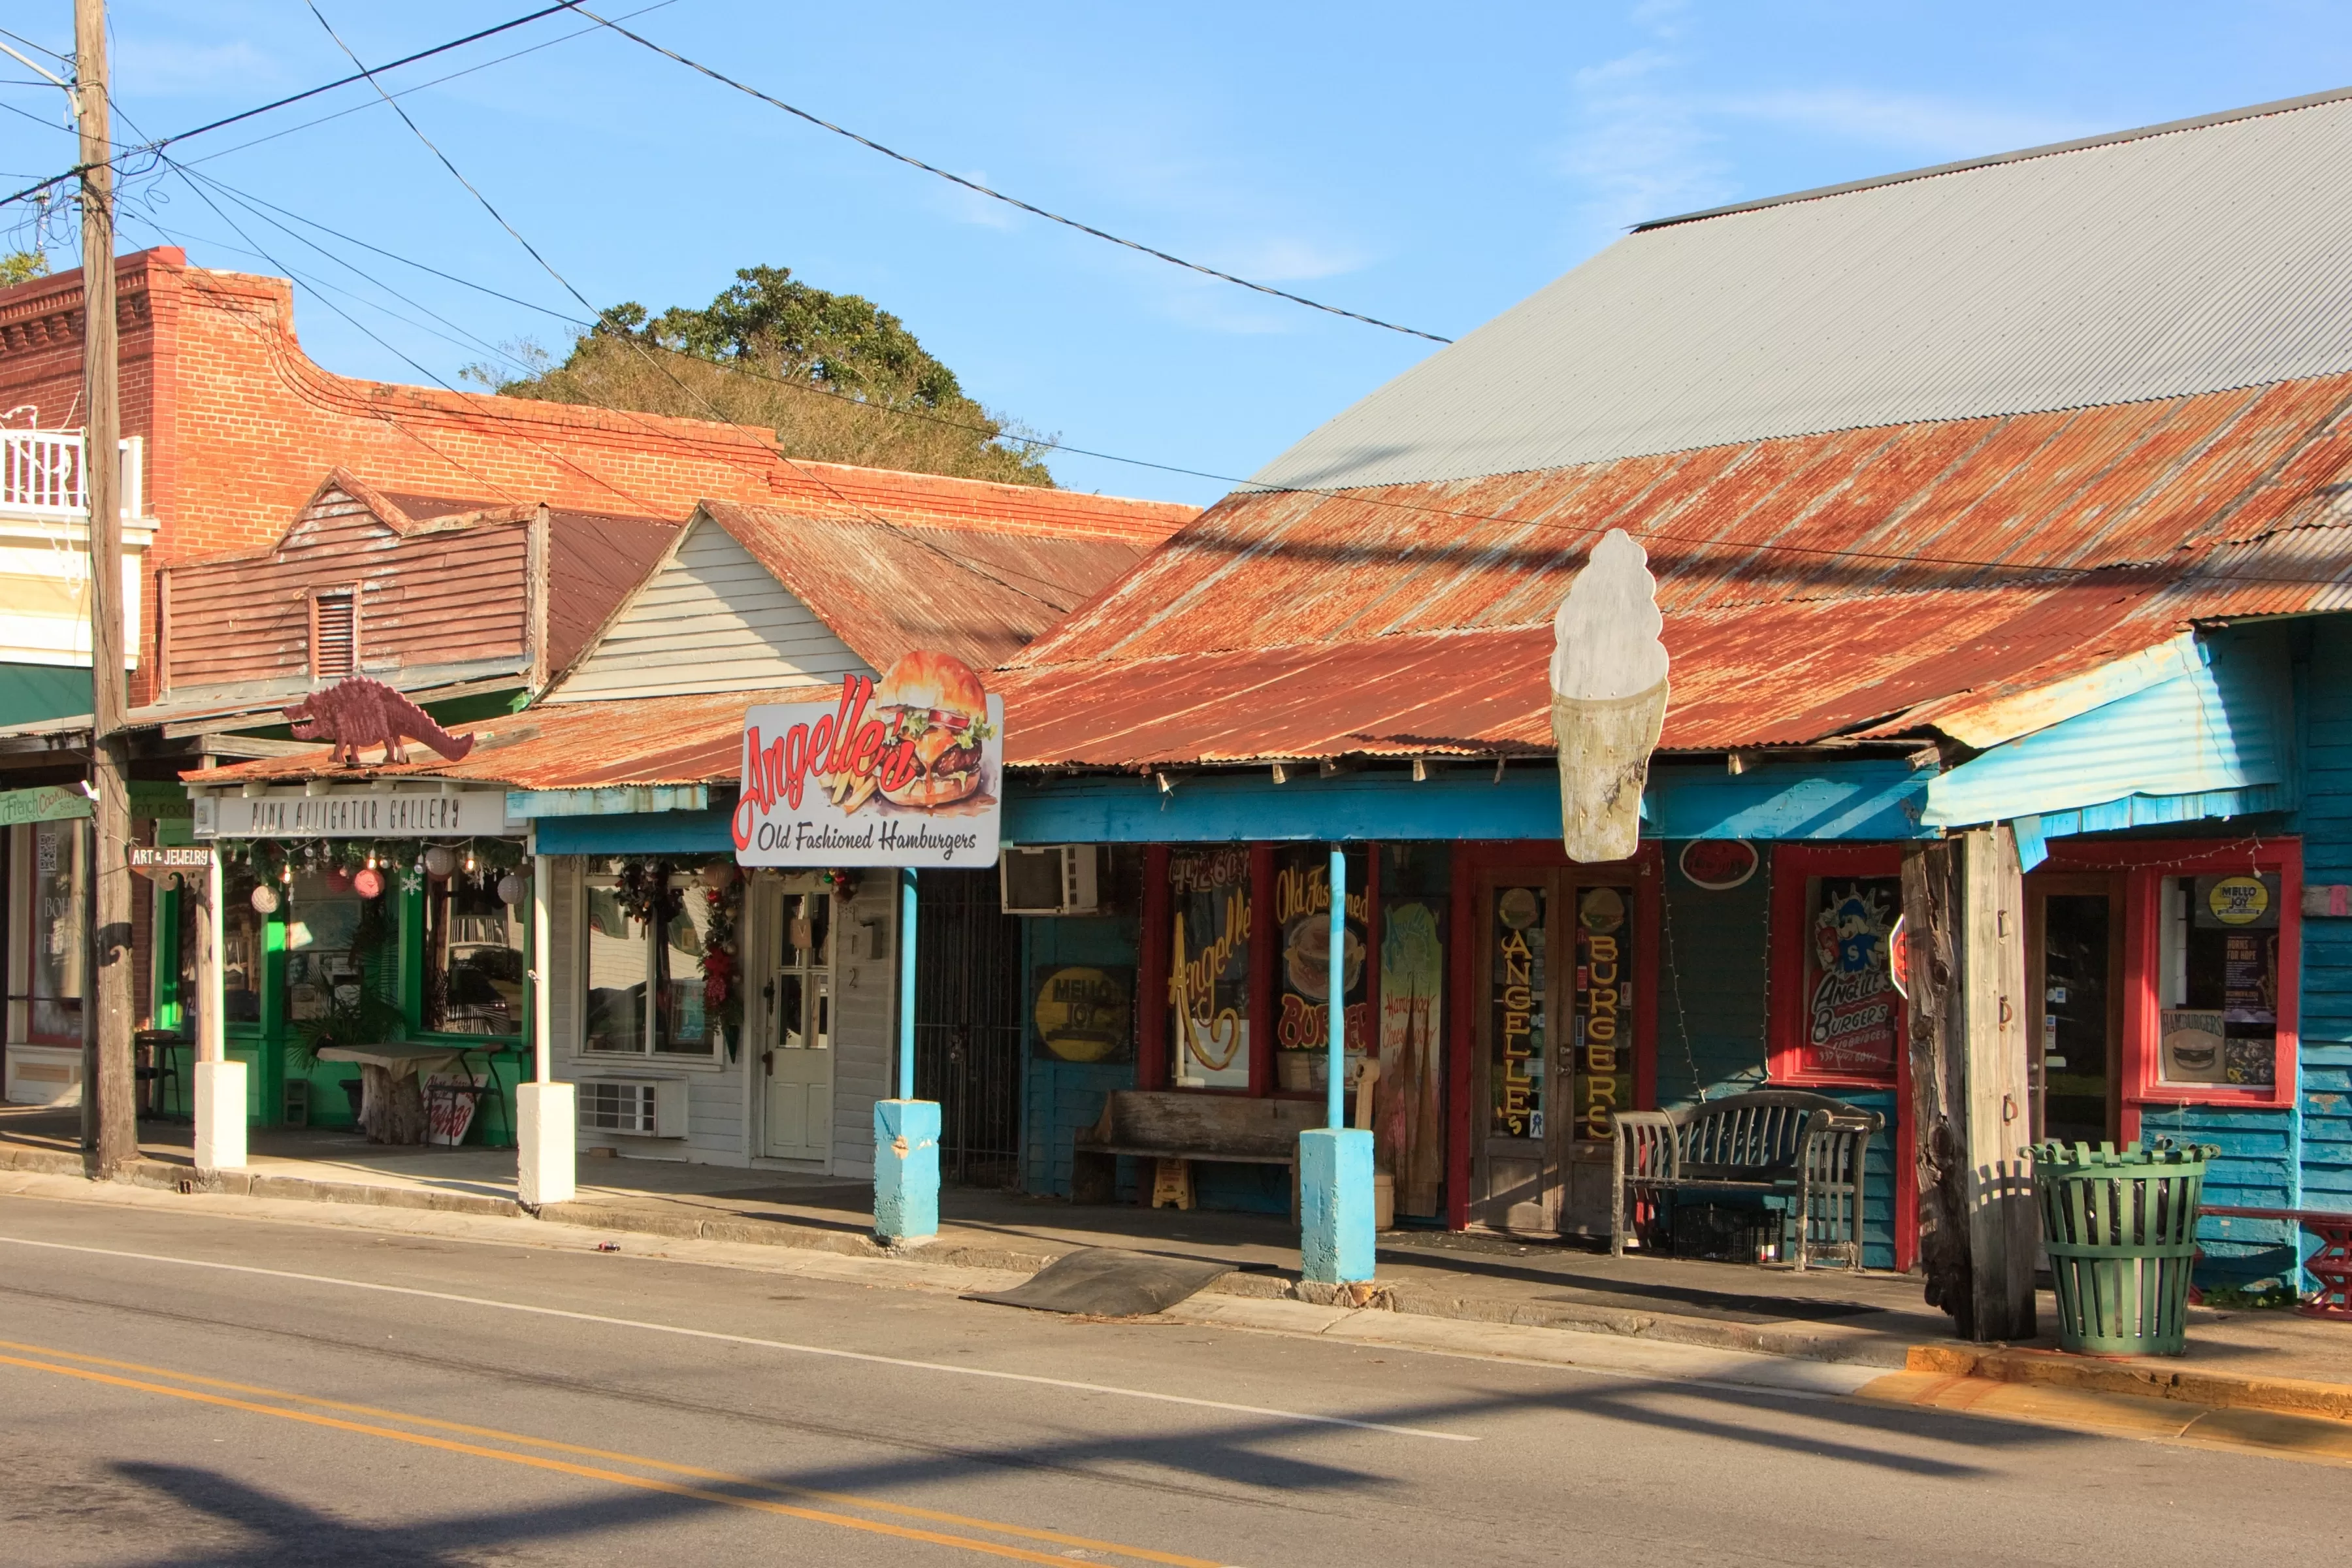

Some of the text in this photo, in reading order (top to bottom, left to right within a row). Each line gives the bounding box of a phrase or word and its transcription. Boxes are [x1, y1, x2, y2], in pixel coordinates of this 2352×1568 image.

[732, 674, 916, 851] Angelle's
[252, 798, 460, 830] PINK ALLIGATOR GALLERY
[132, 849, 209, 865] ART & JEWELRY
[757, 820, 977, 860] Old Fashioned Hamburgers
[1276, 863, 1369, 924] Old Fasned
[2222, 886, 2258, 897] MELLO
[2229, 896, 2249, 909] JOY
[1168, 887, 1251, 1070] Angelle'
[1587, 936, 1619, 1140] BURGERS
[1812, 1005, 1889, 1045] BURGERS
